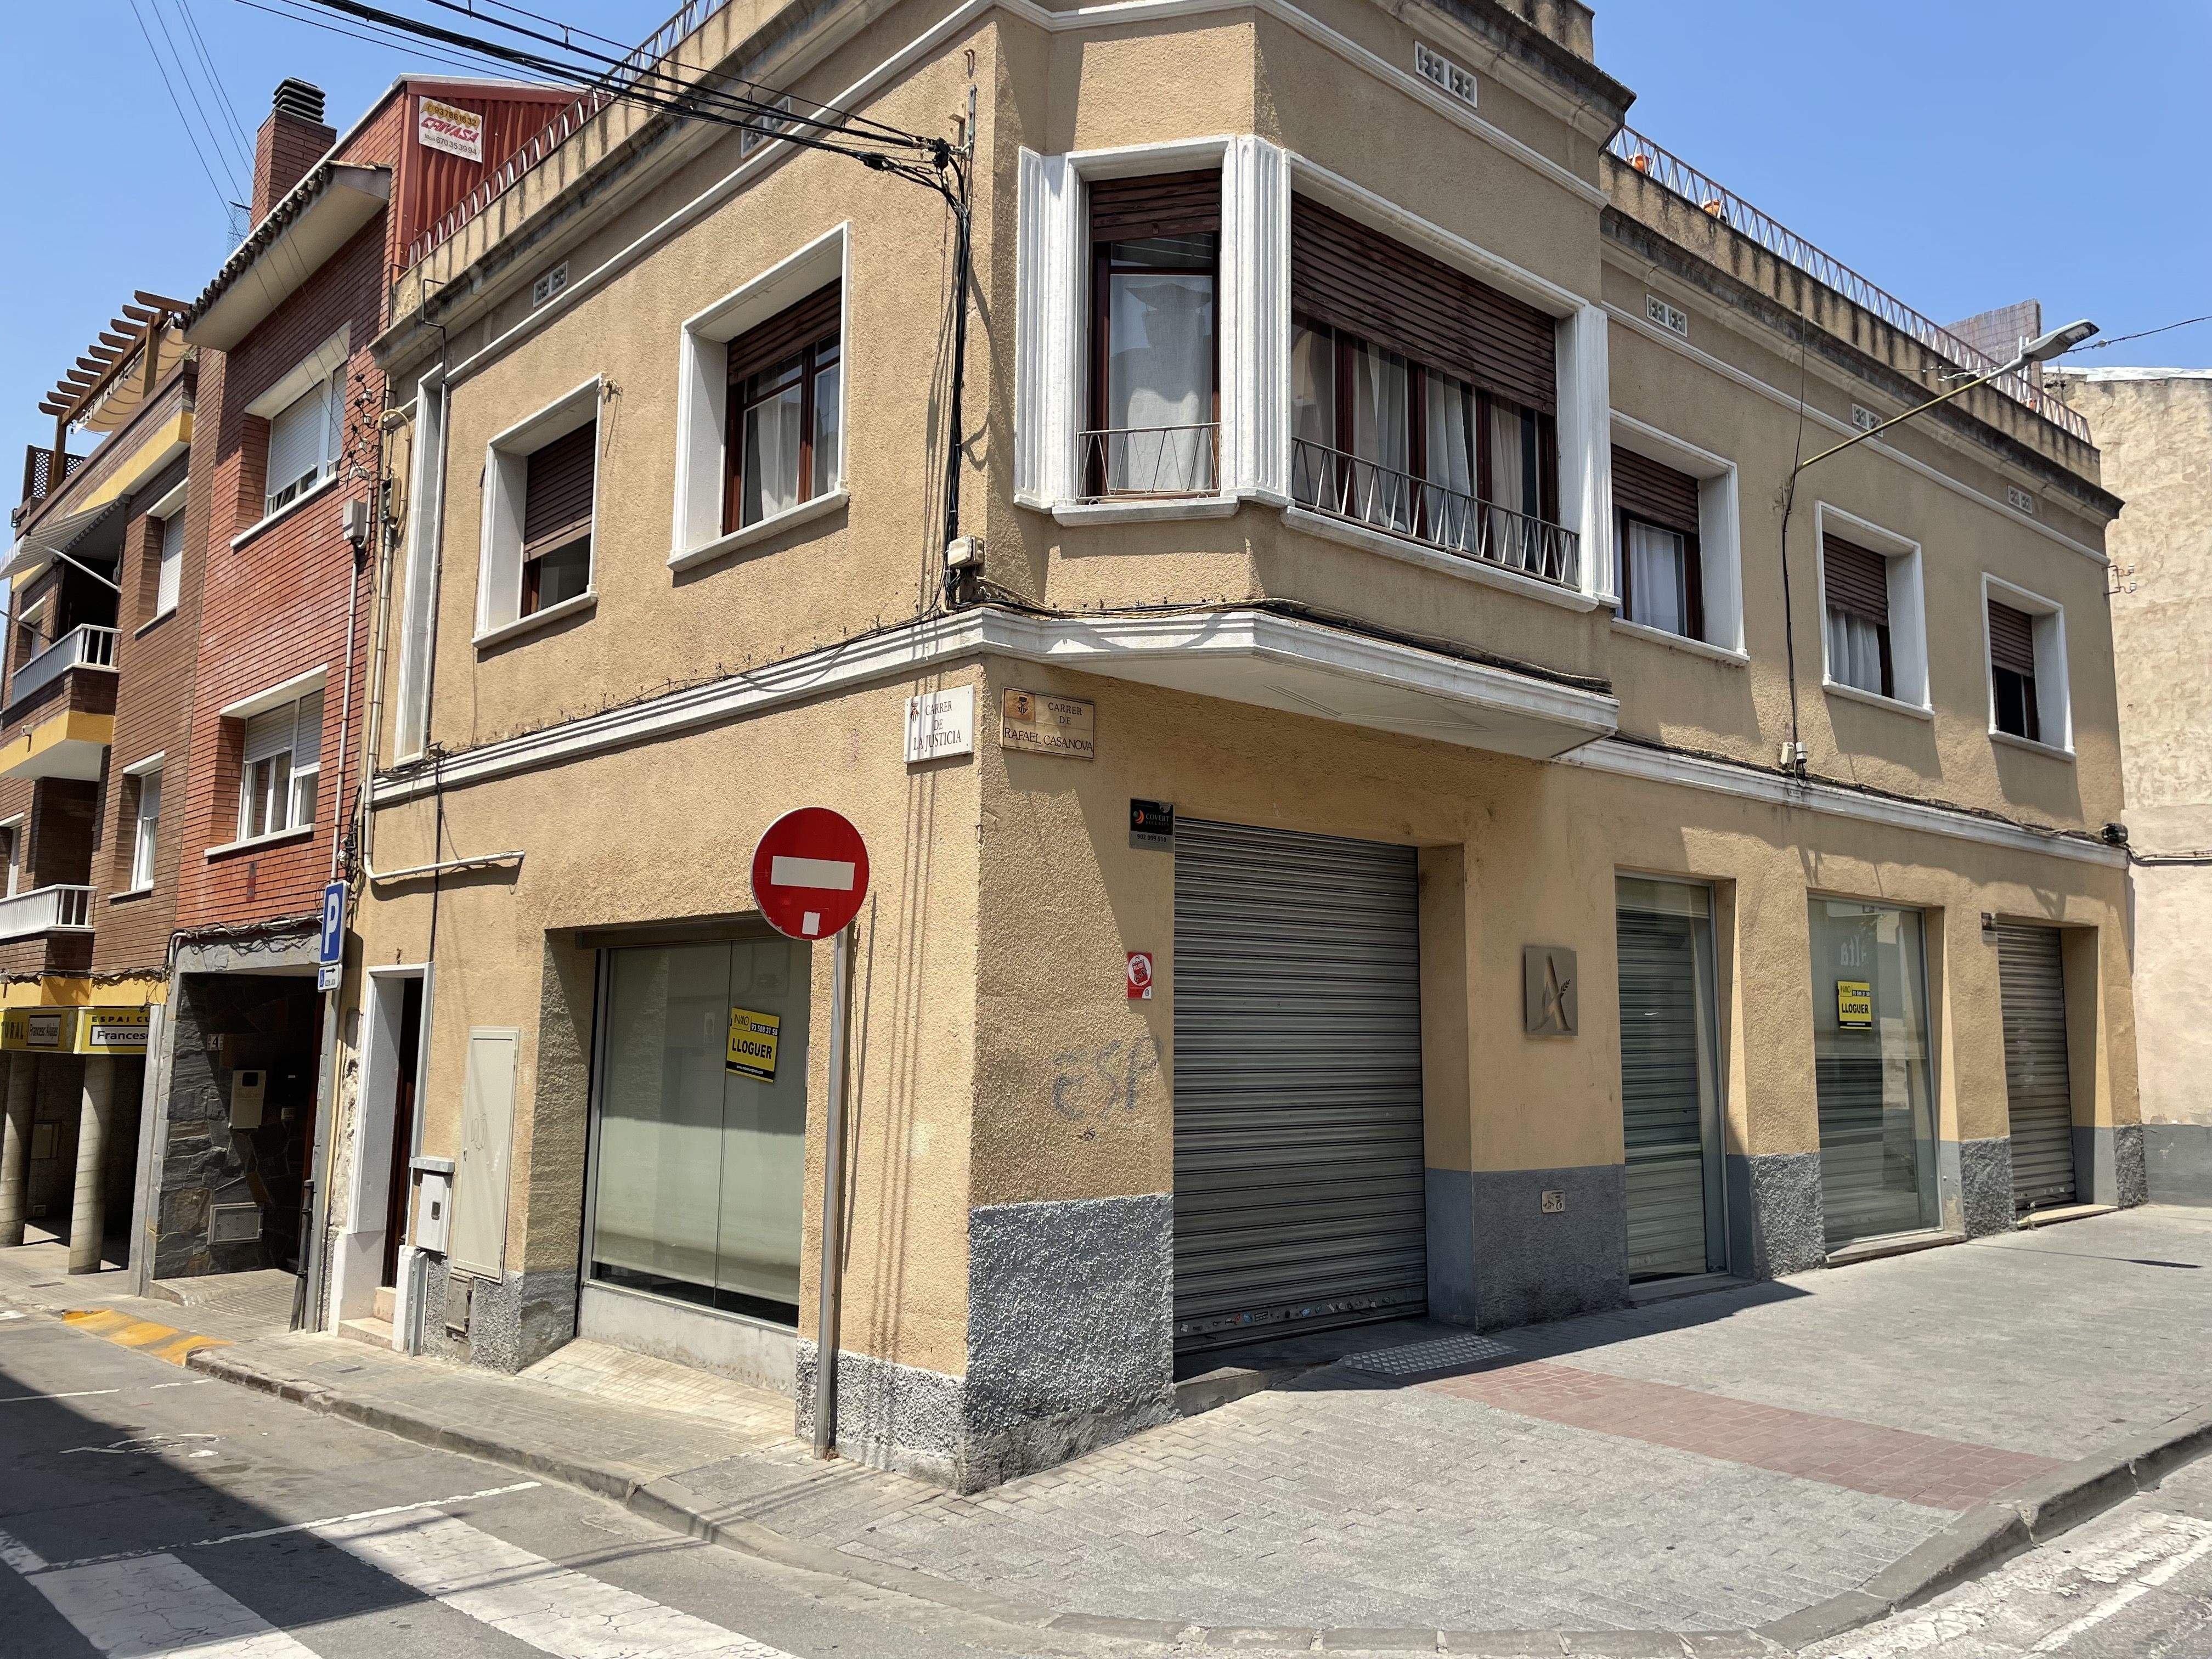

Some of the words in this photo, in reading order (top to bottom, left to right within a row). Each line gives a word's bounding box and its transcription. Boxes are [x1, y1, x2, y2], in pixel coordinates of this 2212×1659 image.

[925, 701, 953, 716] CARRER
[1048, 701, 1083, 716] CARRER
[934, 718, 944, 731] DE
[1059, 715, 1072, 725] DE
[913, 736, 924, 751] LA
[1005, 727, 1042, 744] RAFAEL
[1043, 735, 1094, 752] CASANOVA
[324, 893, 340, 953] P
[1841, 1003, 1869, 1014] LLOGUER
[212, 1036, 219, 1047] 4
[732, 1037, 772, 1059] LLOGUER
